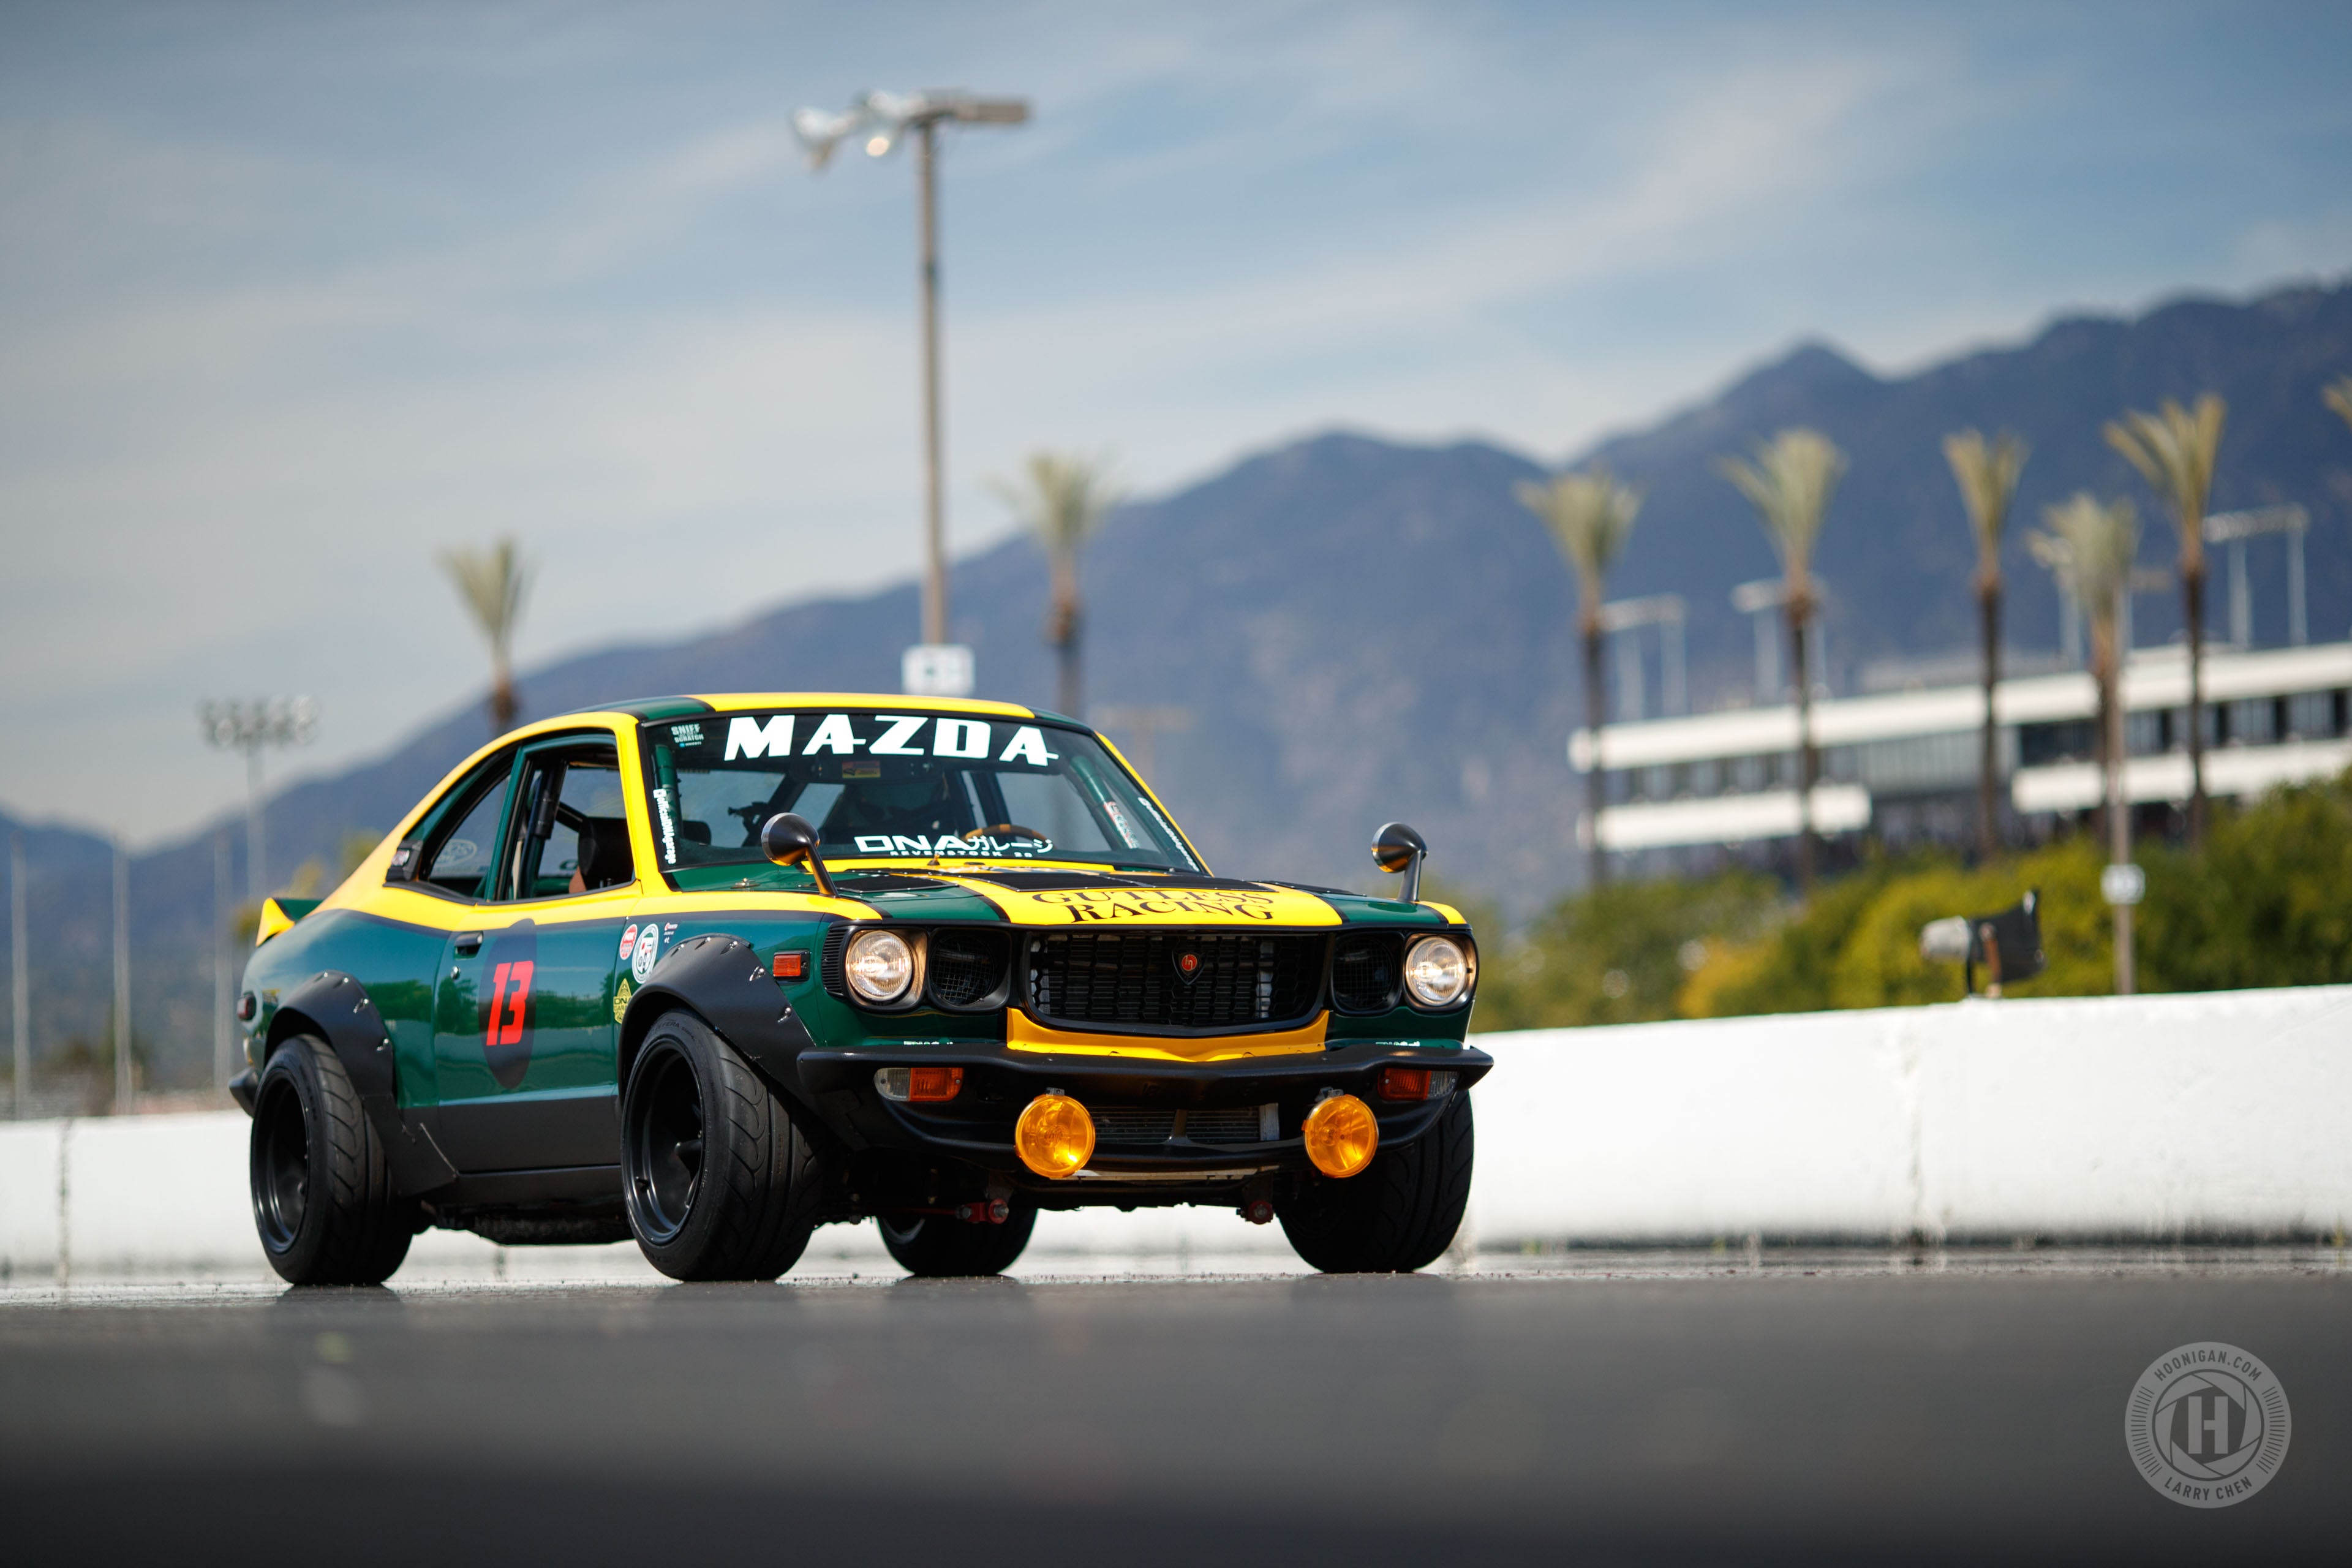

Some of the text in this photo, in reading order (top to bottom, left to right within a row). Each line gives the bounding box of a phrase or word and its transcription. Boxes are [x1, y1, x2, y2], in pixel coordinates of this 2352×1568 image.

[724, 714, 1059, 766] MAZDA
[1031, 890, 1273, 904] GUTLESS
[1065, 900, 1275, 923] RACING
[486, 960, 534, 1046] 13
